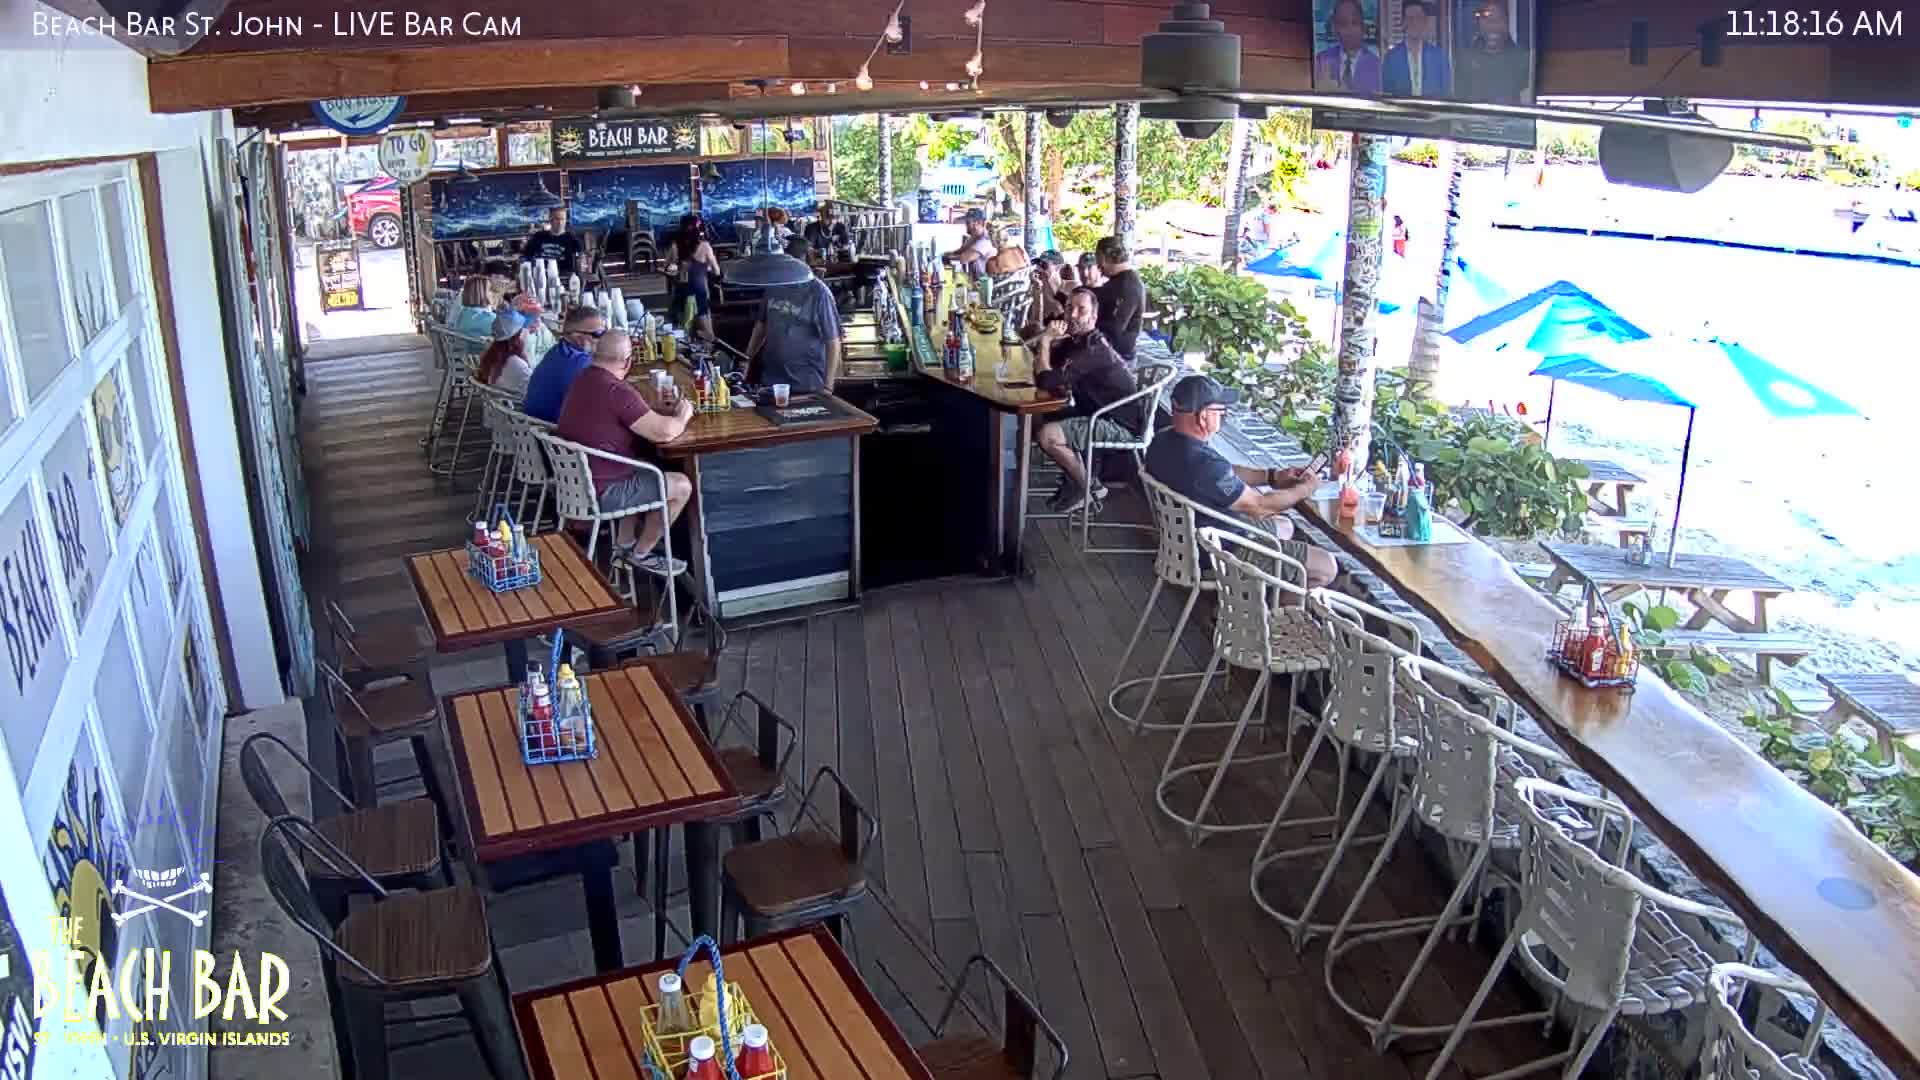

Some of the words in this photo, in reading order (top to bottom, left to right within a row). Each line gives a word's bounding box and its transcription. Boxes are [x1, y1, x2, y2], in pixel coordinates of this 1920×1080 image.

[386, 136, 405, 156] TO
[409, 133, 426, 152] GO
[588, 127, 633, 148] BEACH
[637, 126, 669, 146] BAR
